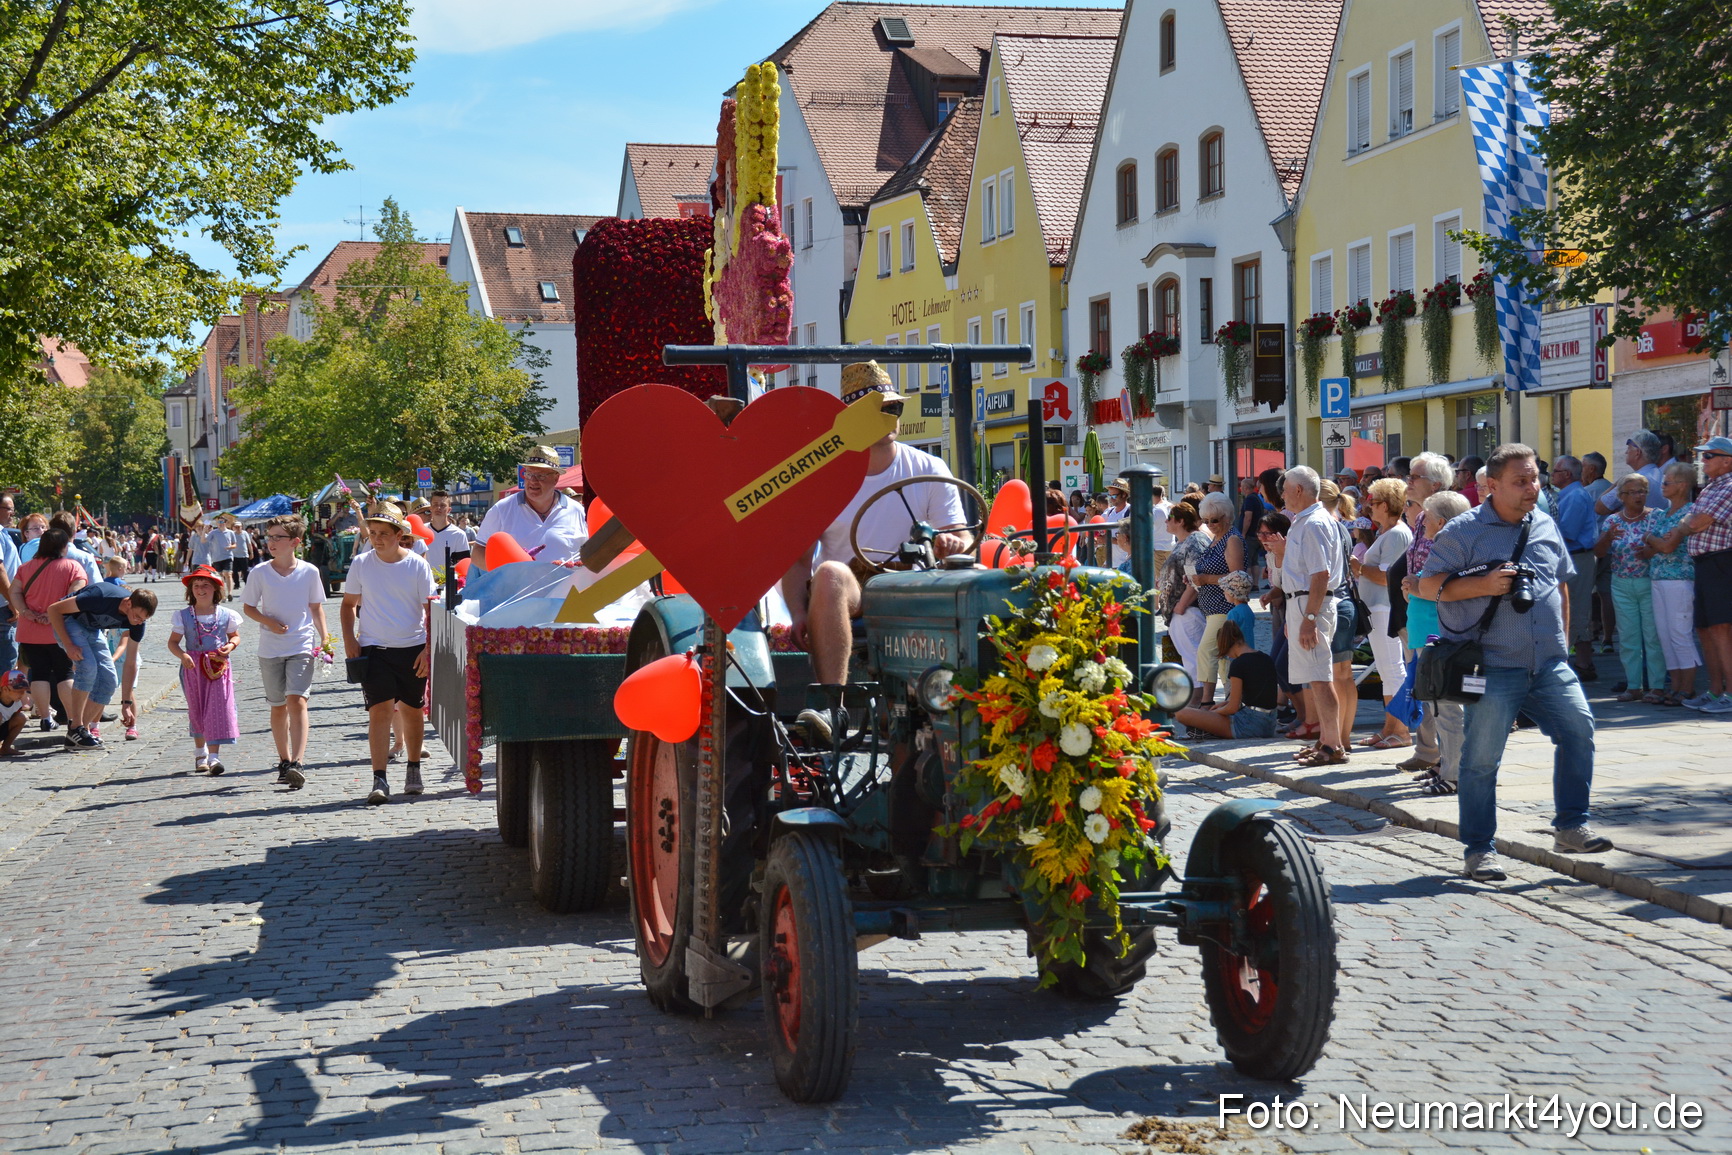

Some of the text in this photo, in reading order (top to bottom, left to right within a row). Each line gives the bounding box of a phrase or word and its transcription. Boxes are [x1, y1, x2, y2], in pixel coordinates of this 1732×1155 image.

[891, 300, 917, 327] HOTEL
[1540, 340, 1580, 360] IALTO KINO
[1594, 308, 1605, 381] KINO
[977, 392, 983, 418] P
[985, 394, 1009, 411] AIFUN
[1326, 383, 1344, 414] P
[899, 420, 926, 436] staurant
[1350, 416, 1362, 430] OLLE
[735, 434, 845, 513] STADTGÄRTNER
[1457, 564, 1488, 577] OLYMPUS
[884, 635, 946, 661] HANOMAG
